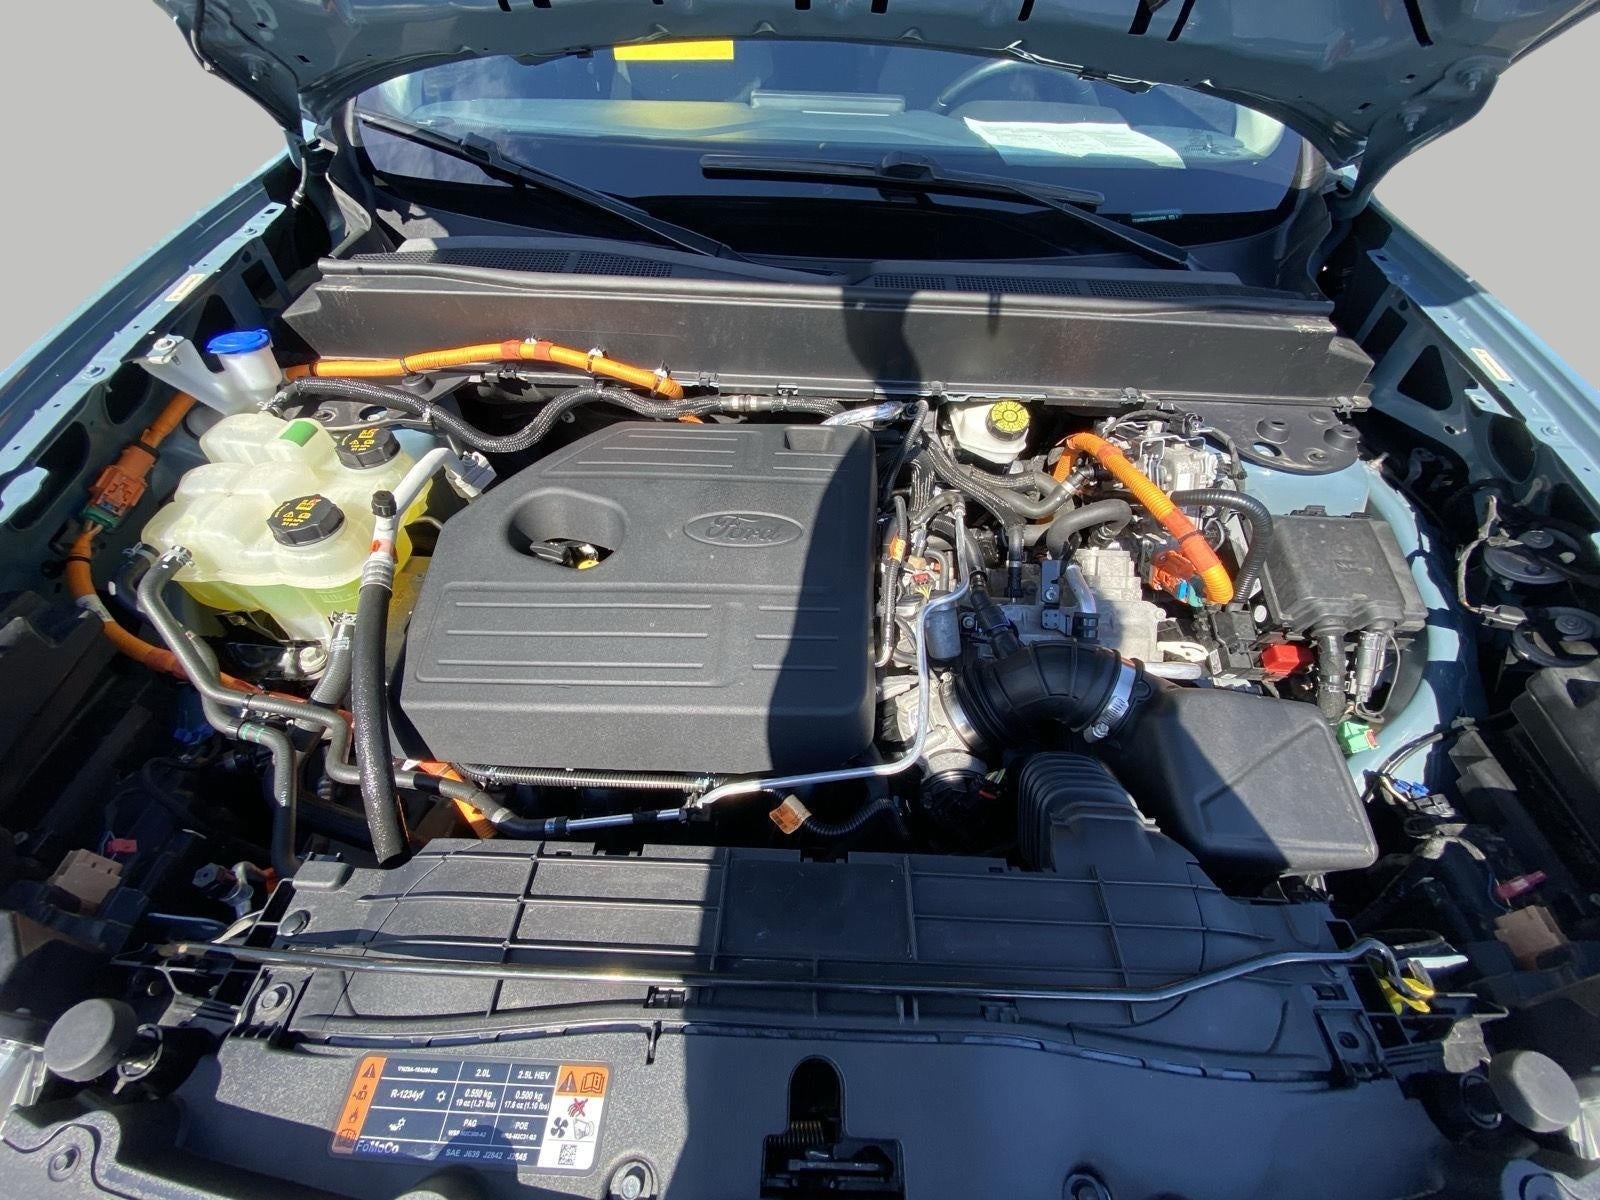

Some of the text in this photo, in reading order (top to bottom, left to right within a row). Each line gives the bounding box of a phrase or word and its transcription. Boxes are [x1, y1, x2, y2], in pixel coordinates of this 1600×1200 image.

[705, 515, 780, 541] Ford
[475, 1068, 491, 1078] 2.0L
[517, 1070, 551, 1080] 2.5L HEV
[390, 1088, 425, 1102] R-1234yf
[484, 1090, 492, 1100] kg
[534, 1092, 544, 1102] kg
[485, 1100, 497, 1109] lbs)
[463, 1118, 477, 1127] PAG
[514, 1122, 529, 1130] POE
[356, 1140, 400, 1154] FoMoCo
[446, 1149, 461, 1157] SAE
